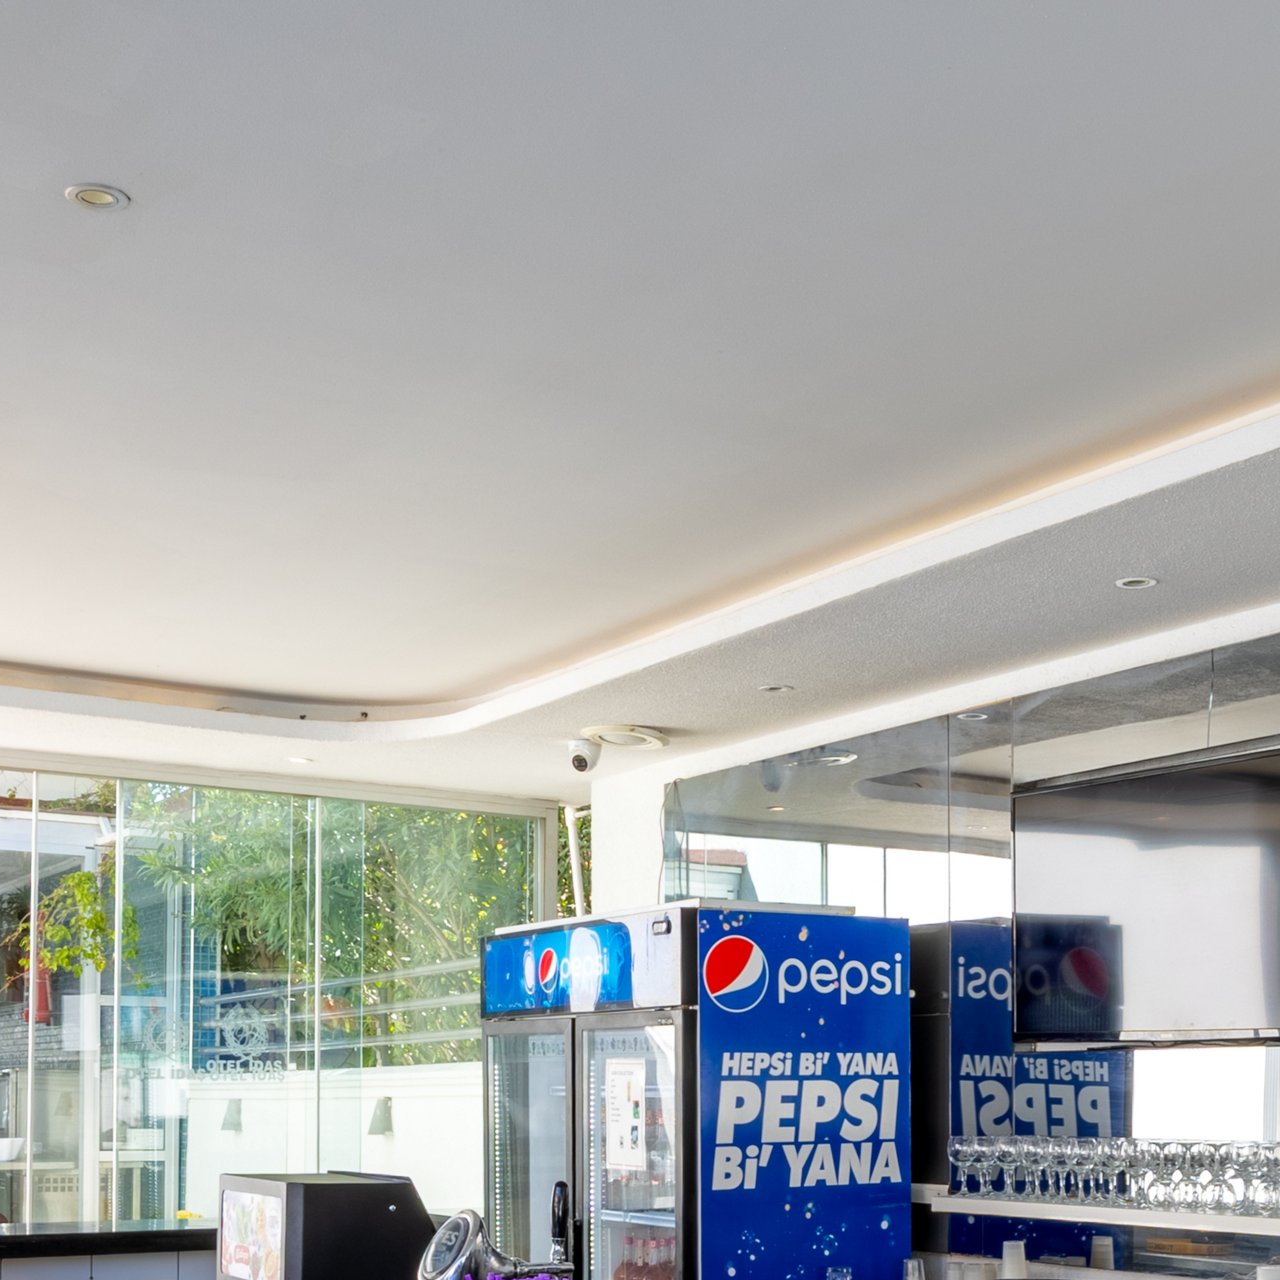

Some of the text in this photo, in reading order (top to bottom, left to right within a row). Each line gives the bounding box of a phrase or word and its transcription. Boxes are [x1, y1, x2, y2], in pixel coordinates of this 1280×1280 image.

[560, 948, 609, 984] pepsi
[778, 952, 902, 1005] pepsi
[837, 1052, 900, 1076] YANA
[716, 1079, 900, 1144] PEPSI
[782, 1141, 902, 1188] YANA
